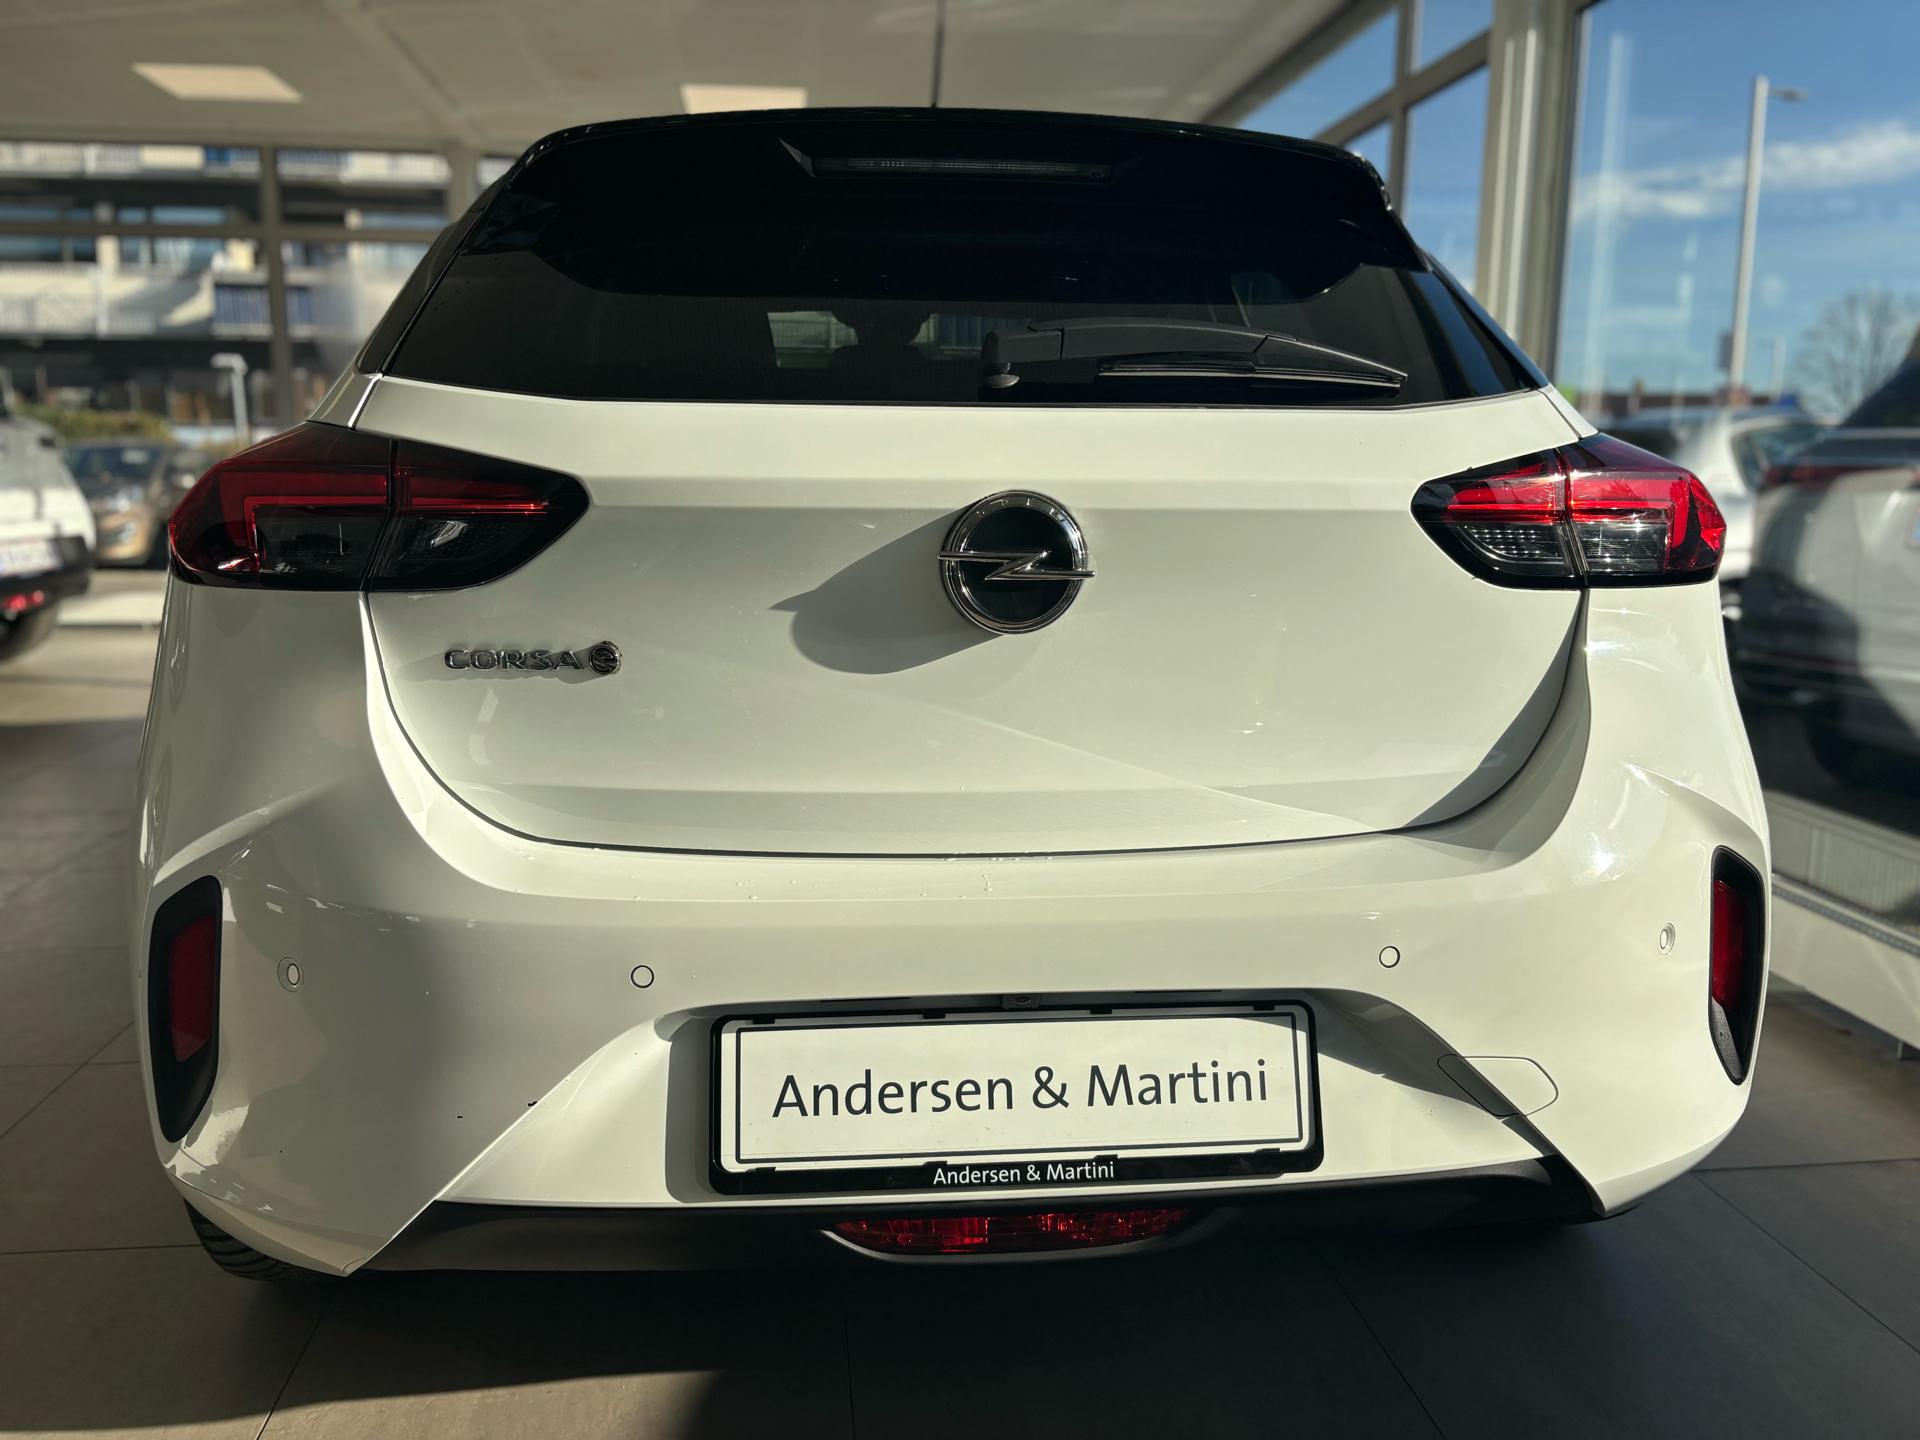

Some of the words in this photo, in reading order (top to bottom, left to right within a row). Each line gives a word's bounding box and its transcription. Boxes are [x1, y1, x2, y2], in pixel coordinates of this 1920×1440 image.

[444, 650, 584, 671] CORSA
[772, 1069, 1013, 1118] Andersen
[1032, 1066, 1070, 1109] &
[1087, 1058, 1268, 1107] Martini
[933, 1165, 1021, 1185] Andersen
[1026, 1164, 1041, 1182] &
[1046, 1160, 1115, 1181] Martini
